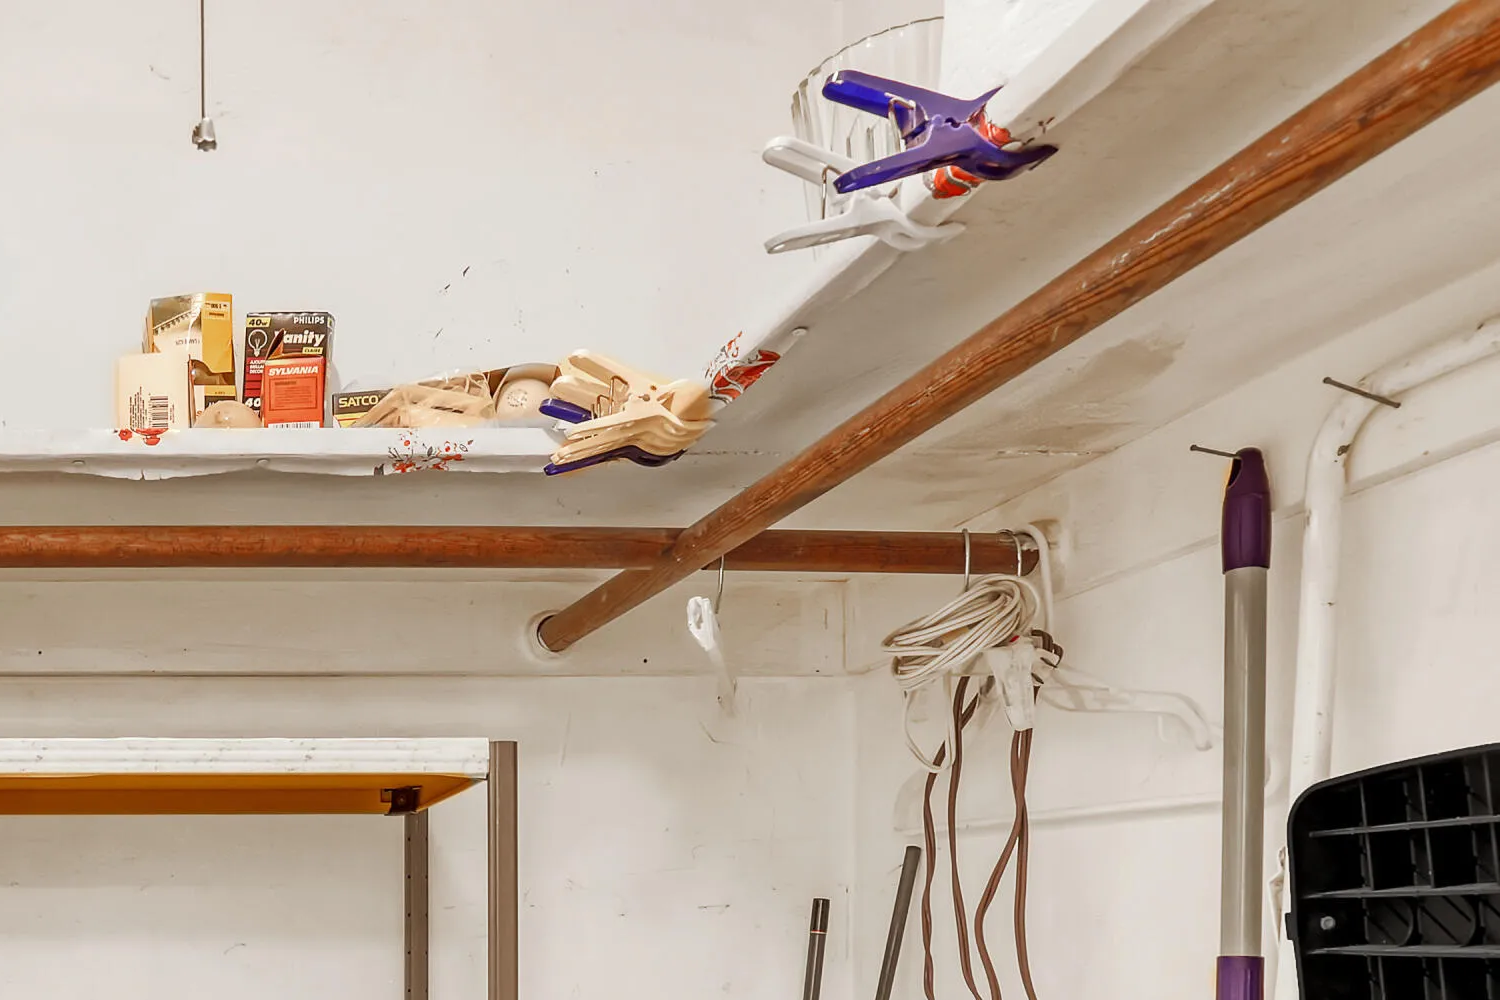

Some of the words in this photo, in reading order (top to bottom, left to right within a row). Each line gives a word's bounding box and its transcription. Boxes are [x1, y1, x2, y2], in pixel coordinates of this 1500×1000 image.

[293, 316, 325, 325] PHILIPS
[268, 366, 319, 376] SYLVANIA
[338, 394, 379, 408] SATCO
